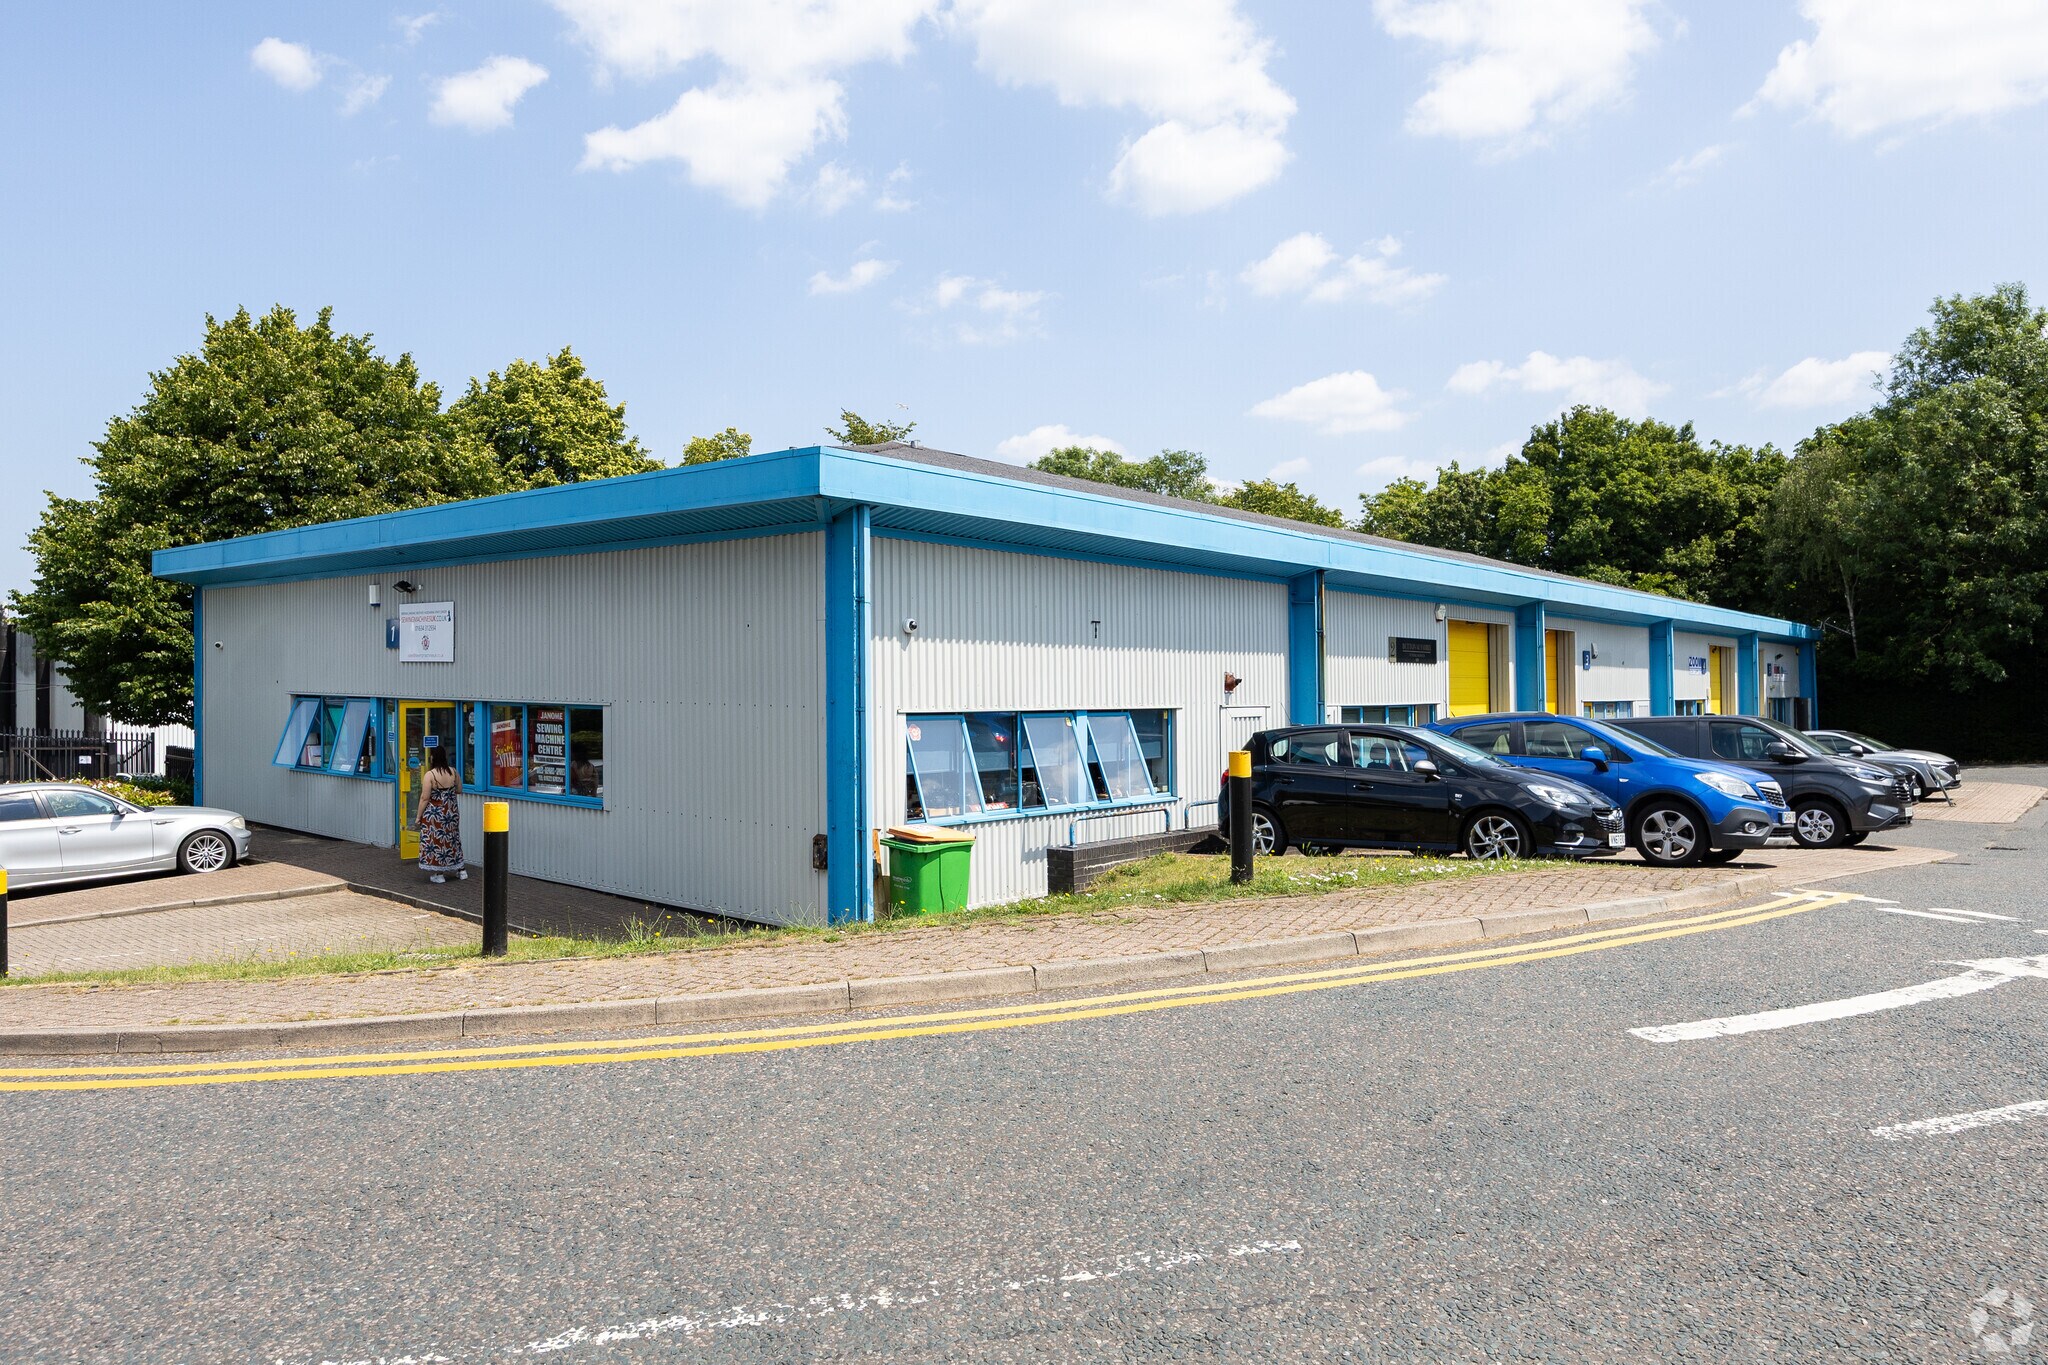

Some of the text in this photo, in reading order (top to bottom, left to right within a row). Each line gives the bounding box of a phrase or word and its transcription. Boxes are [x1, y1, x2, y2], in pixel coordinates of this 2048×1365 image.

[391, 626, 395, 642] 1
[1585, 654, 1589, 665] 3
[540, 712, 563, 720] JANOME
[536, 723, 563, 734] SEWING
[535, 734, 565, 745] MACHINE
[538, 744, 563, 756] CENTRE
